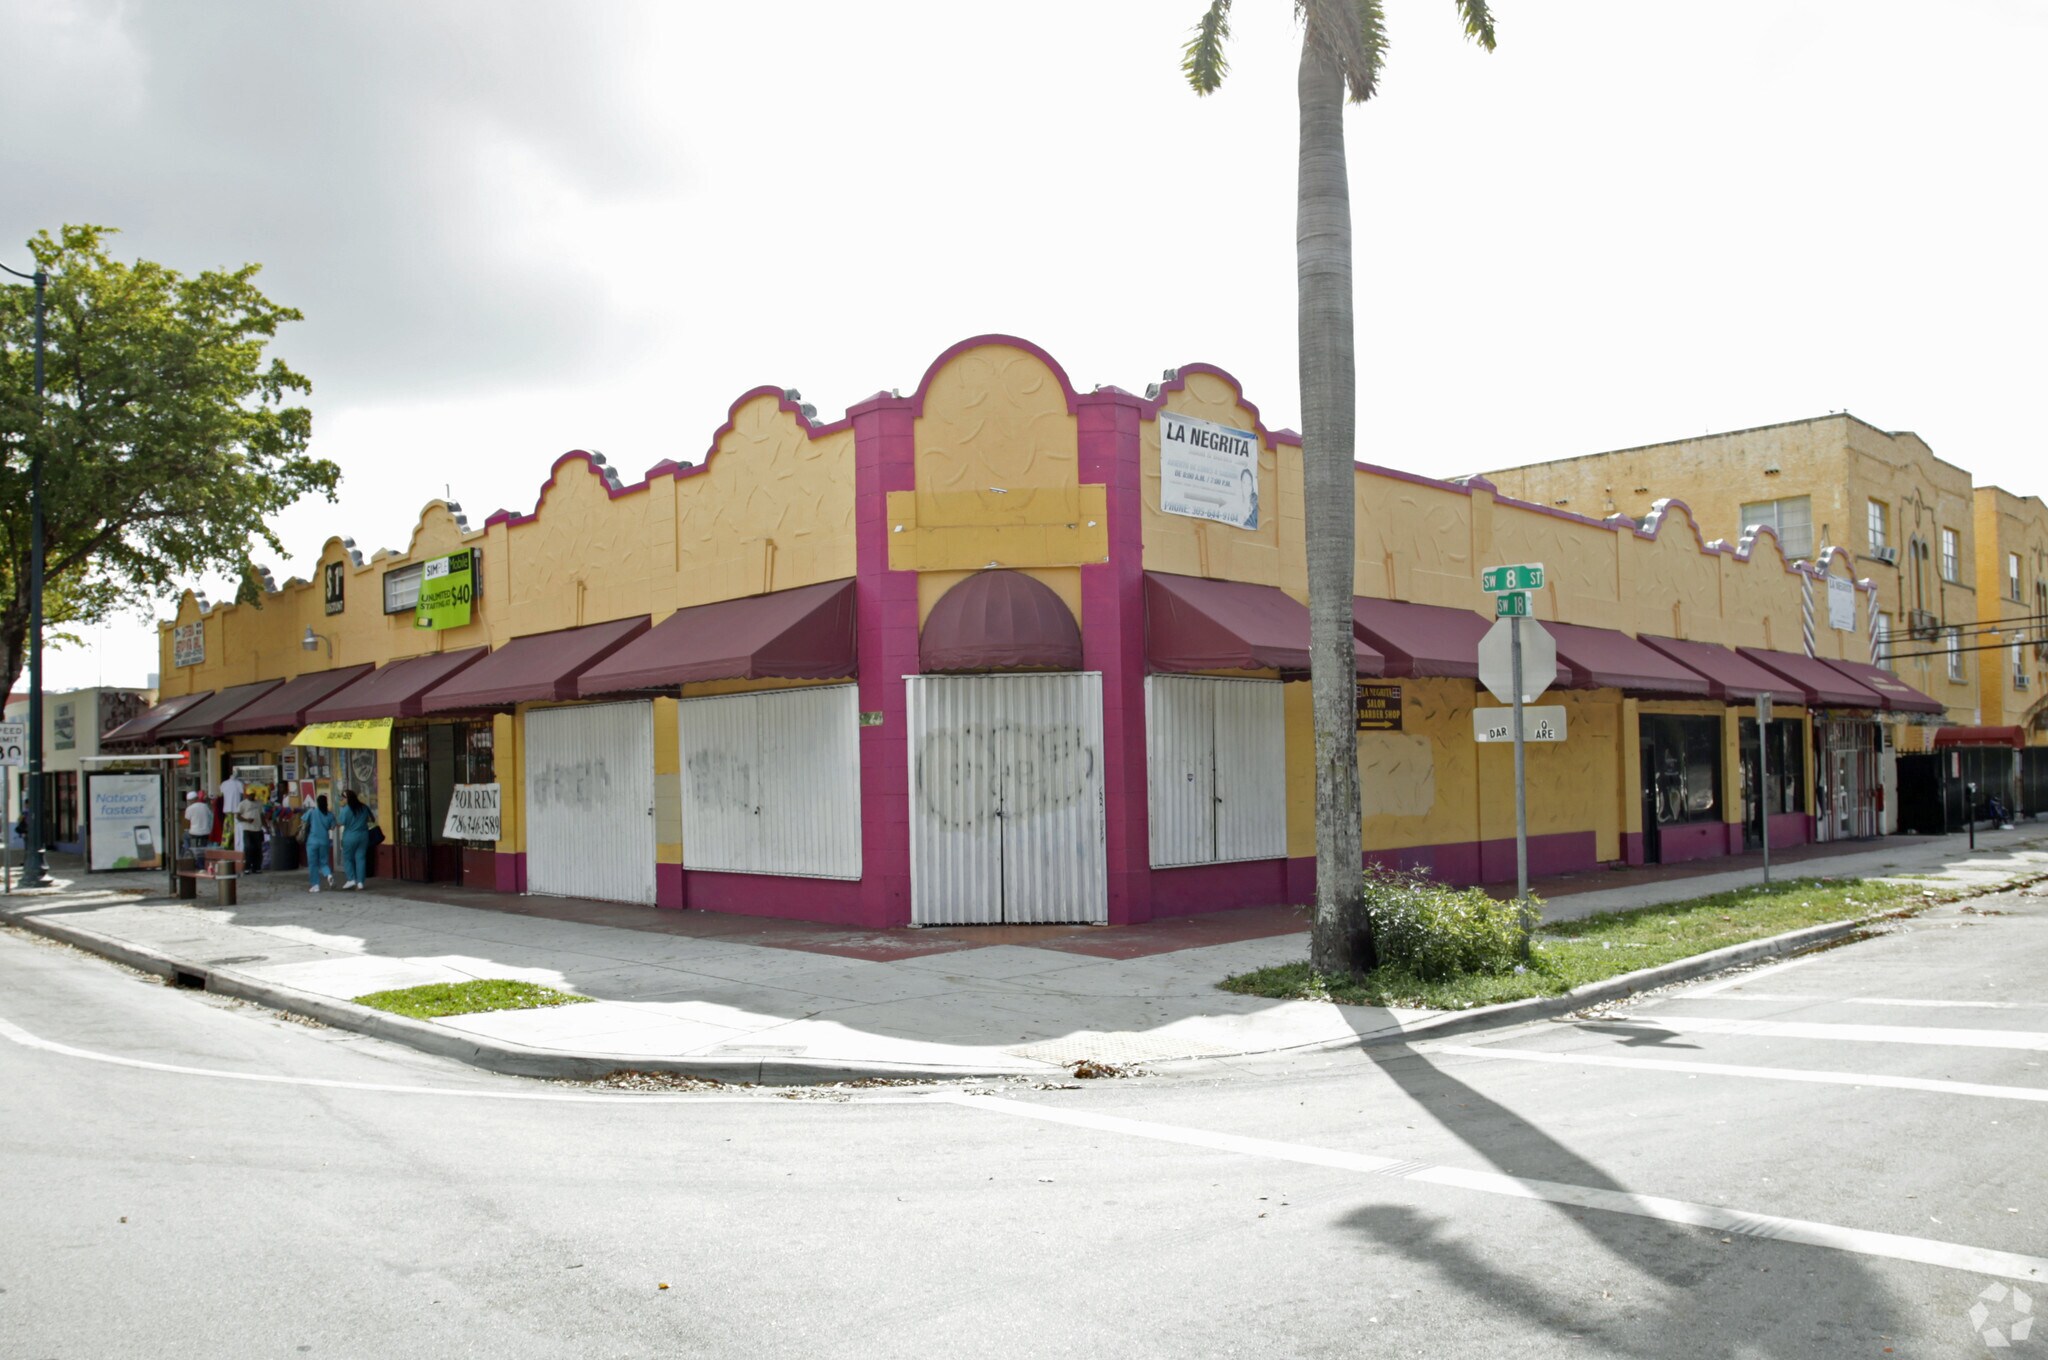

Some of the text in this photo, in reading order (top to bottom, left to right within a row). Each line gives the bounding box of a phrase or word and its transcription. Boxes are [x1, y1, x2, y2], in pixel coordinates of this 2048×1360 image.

[1166, 421, 1185, 443] LA
[1190, 427, 1249, 458] NEGRITA
[426, 560, 448, 577] SIMPLE
[1484, 569, 1542, 589] SW 8 ST
[421, 589, 450, 602] UNLIMITED
[451, 584, 470, 610] $40
[1498, 596, 1524, 615] SW 18
[1367, 700, 1385, 709] SALON
[1360, 710, 1383, 718] BARBER
[1385, 710, 1400, 718] SHOP
[1489, 726, 1508, 738] DAR
[1535, 729, 1554, 739] ARE
[96, 792, 147, 804] Nation's
[474, 790, 497, 808] RENT
[101, 804, 145, 815] fastest
